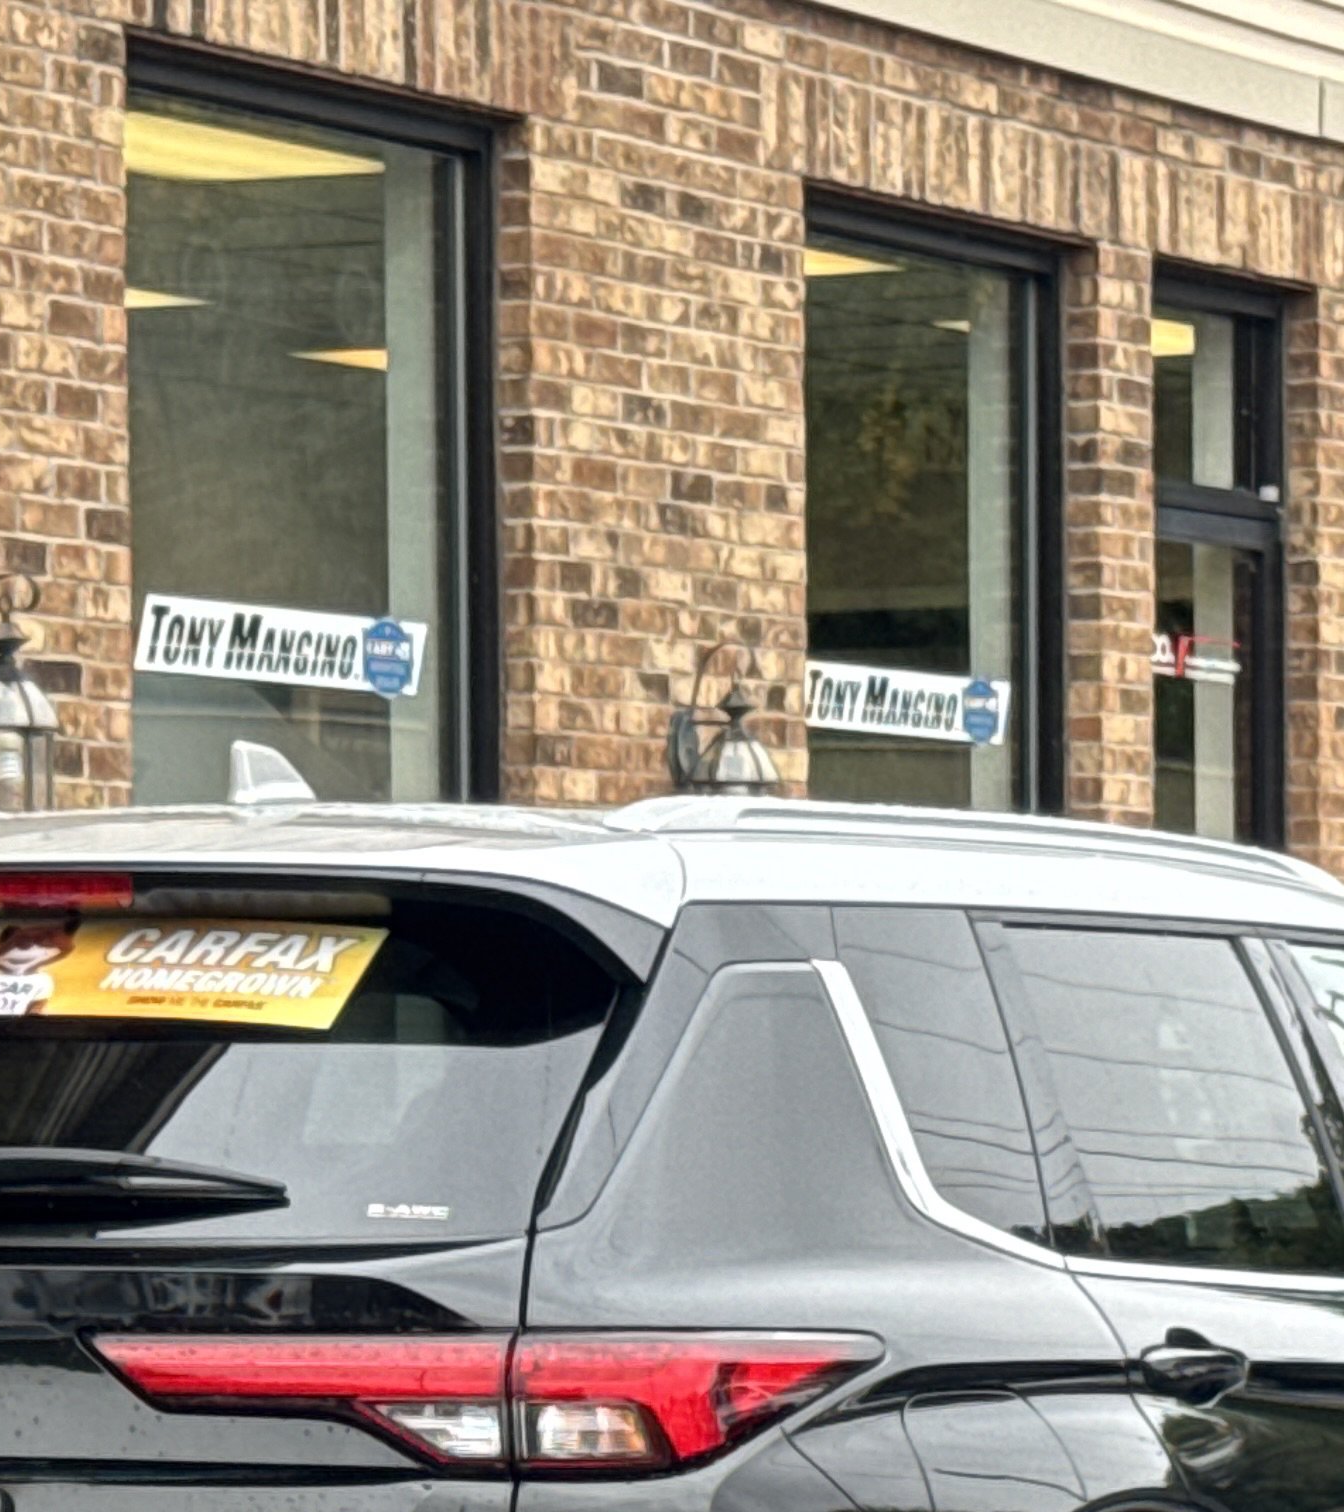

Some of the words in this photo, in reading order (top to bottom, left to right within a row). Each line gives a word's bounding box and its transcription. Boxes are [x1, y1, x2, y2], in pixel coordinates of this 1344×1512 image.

[146, 604, 226, 668] TONY
[805, 669, 862, 722] TONY
[106, 927, 356, 973] CARFAX
[99, 967, 324, 998] HOMEGROWN
